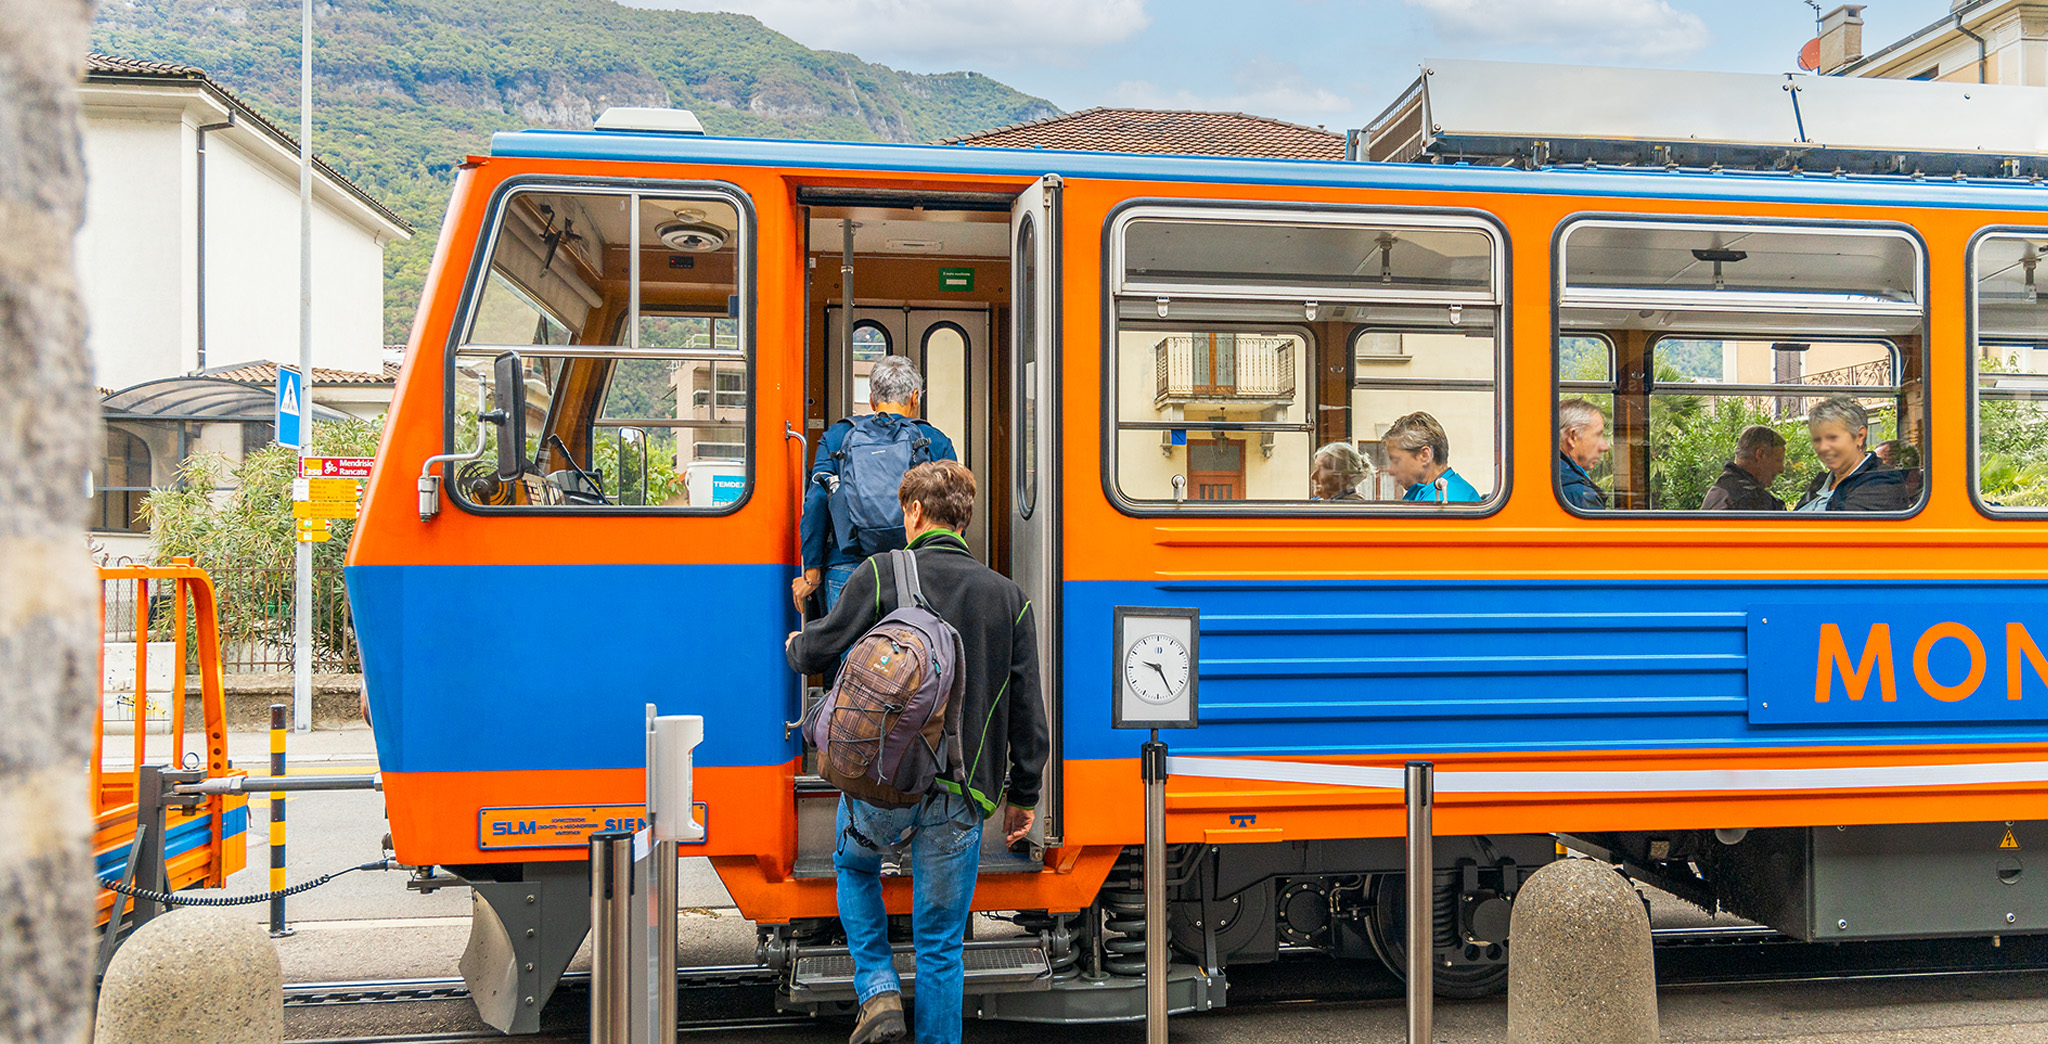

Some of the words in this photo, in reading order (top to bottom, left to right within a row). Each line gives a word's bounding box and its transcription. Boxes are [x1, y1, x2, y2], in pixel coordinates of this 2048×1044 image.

[339, 459, 374, 467] Mendrisio
[1815, 621, 2048, 703] MON
[492, 820, 536, 835] SLM
